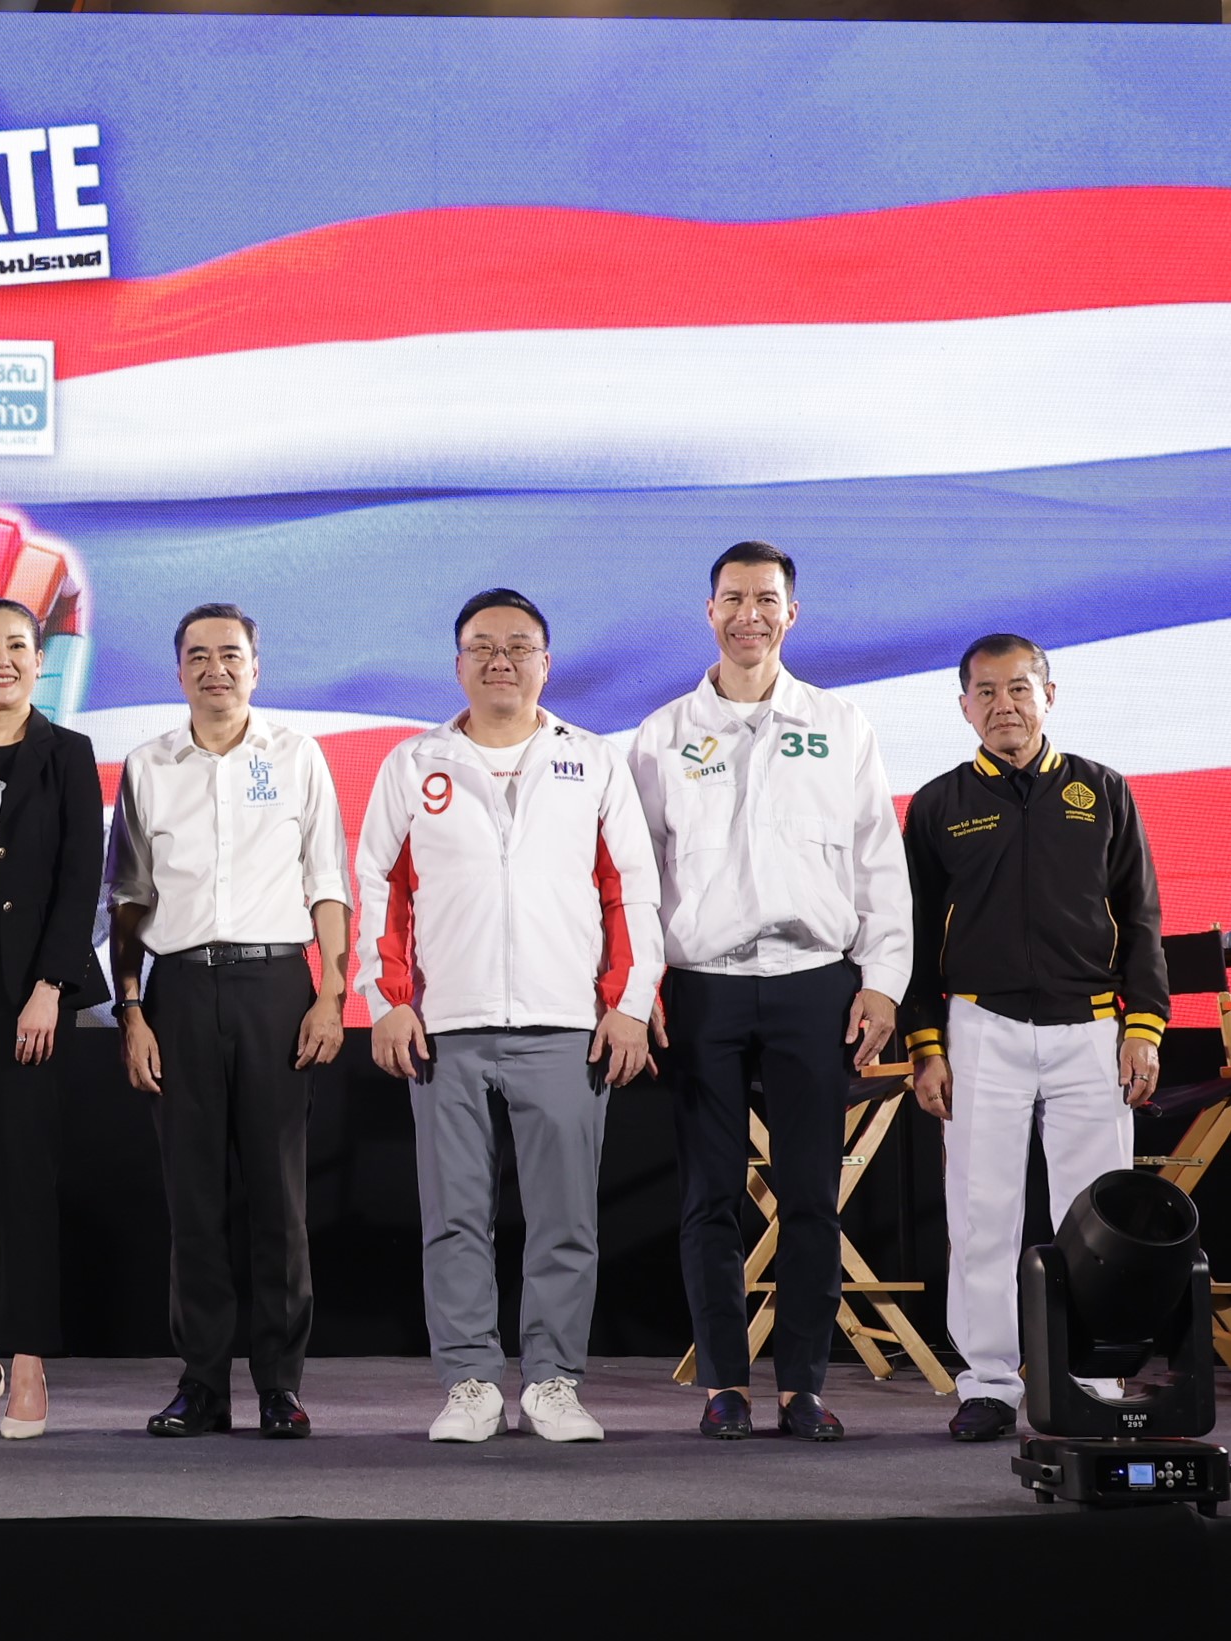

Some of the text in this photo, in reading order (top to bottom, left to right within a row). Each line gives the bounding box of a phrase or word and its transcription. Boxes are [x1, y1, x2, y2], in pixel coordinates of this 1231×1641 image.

[780, 732, 830, 759] 35
[422, 772, 453, 815] 9
[1122, 1414, 1148, 1422] BEAM
